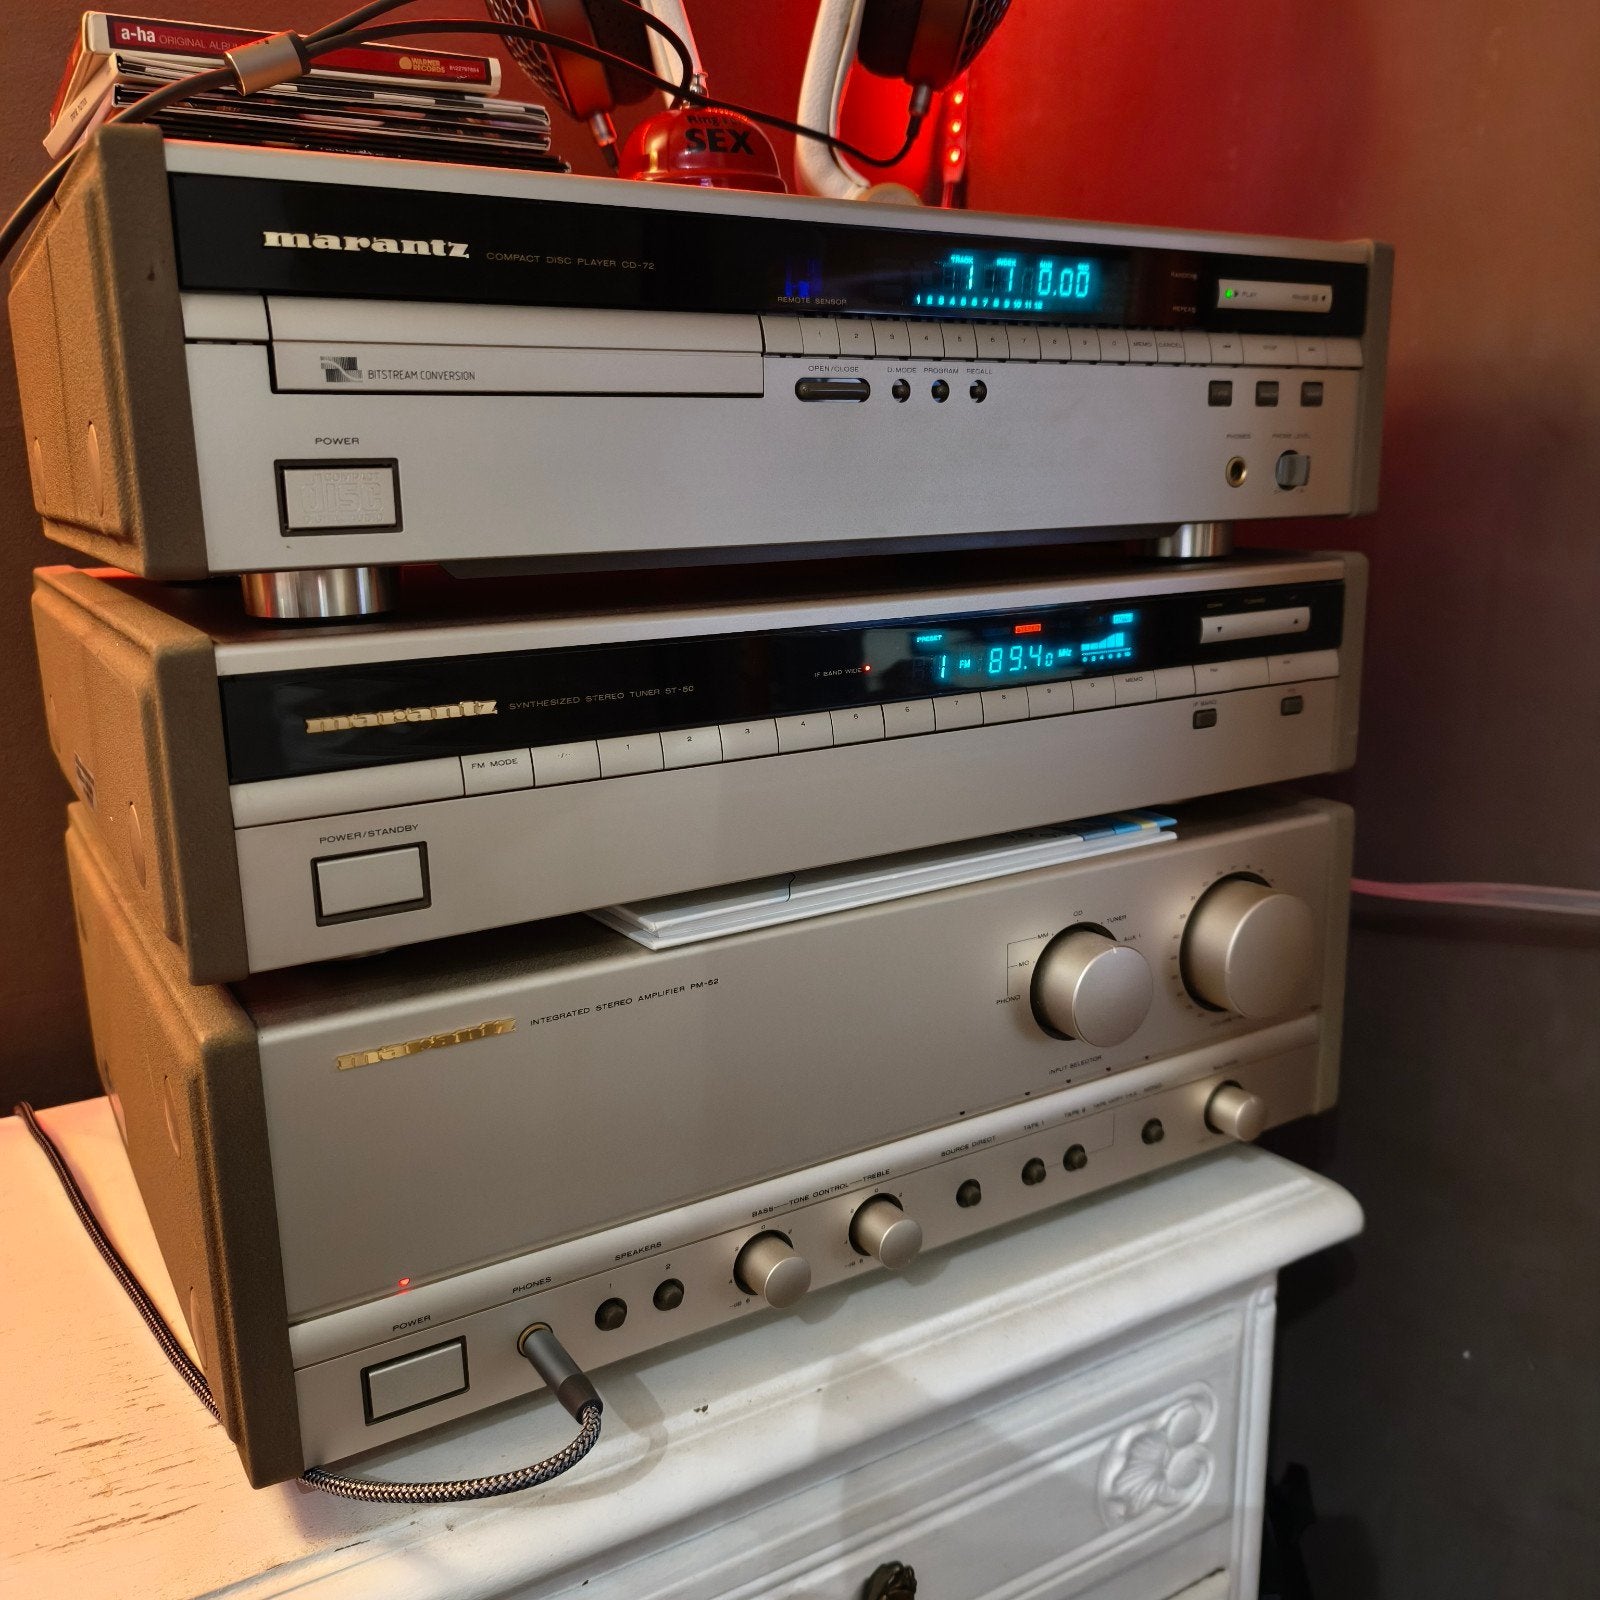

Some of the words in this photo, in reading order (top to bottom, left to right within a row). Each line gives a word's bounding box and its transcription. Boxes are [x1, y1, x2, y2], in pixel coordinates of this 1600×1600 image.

[121, 26, 156, 43] a-ha
[159, 35, 205, 49] ORIGINAL
[412, 57, 441, 66] WARNER
[412, 65, 446, 74] RECORDS
[685, 127, 756, 156] SEX
[263, 231, 469, 258] marantz
[486, 252, 541, 264] COMPACT
[546, 256, 572, 265] DISC
[577, 258, 616, 267] PLAYER
[621, 261, 655, 270] CD-72
[951, 254, 974, 265] TRACK
[777, 296, 811, 304] REMOTE
[815, 297, 847, 306] SENSOR
[367, 369, 418, 381] BITSTREAM
[420, 371, 476, 382] CONVERSION
[808, 365, 860, 373] OPEN/CLOSE
[887, 366, 917, 374] D.MODE
[314, 437, 360, 446] POWER
[959, 658, 971, 669] FM
[823, 669, 843, 677] BAND
[509, 696, 581, 710] SYNTHESIZED
[585, 692, 625, 703] STEREO
[629, 688, 660, 698] TUNER
[305, 700, 498, 734] marantz
[471, 762, 485, 770] FM
[490, 757, 518, 768] MODE
[319, 823, 419, 844] POWER/STANDBY
[1106, 914, 1127, 924] TUNER
[1037, 931, 1049, 940] MM
[530, 1007, 591, 1027] INTEGRATED
[595, 998, 633, 1012] STEREO
[638, 986, 685, 1002] AMPLIFIER
[996, 994, 1021, 1005] PHONO
[336, 1017, 518, 1071] marantz
[1049, 1064, 1068, 1076] INPUT
[1070, 1055, 1102, 1070] SELECTOR
[1023, 1122, 1039, 1131] TAPE
[941, 1143, 969, 1157] SOURCE
[972, 1135, 996, 1147] DIRECT
[751, 1206, 774, 1218] BASS
[788, 1194, 810, 1206] TONE
[812, 1183, 849, 1199] CONTROL
[862, 1169, 890, 1182] TREBLE
[614, 1241, 662, 1261] SPEAKERS
[512, 1276, 552, 1293] PHONES
[392, 1314, 432, 1332] POWER
